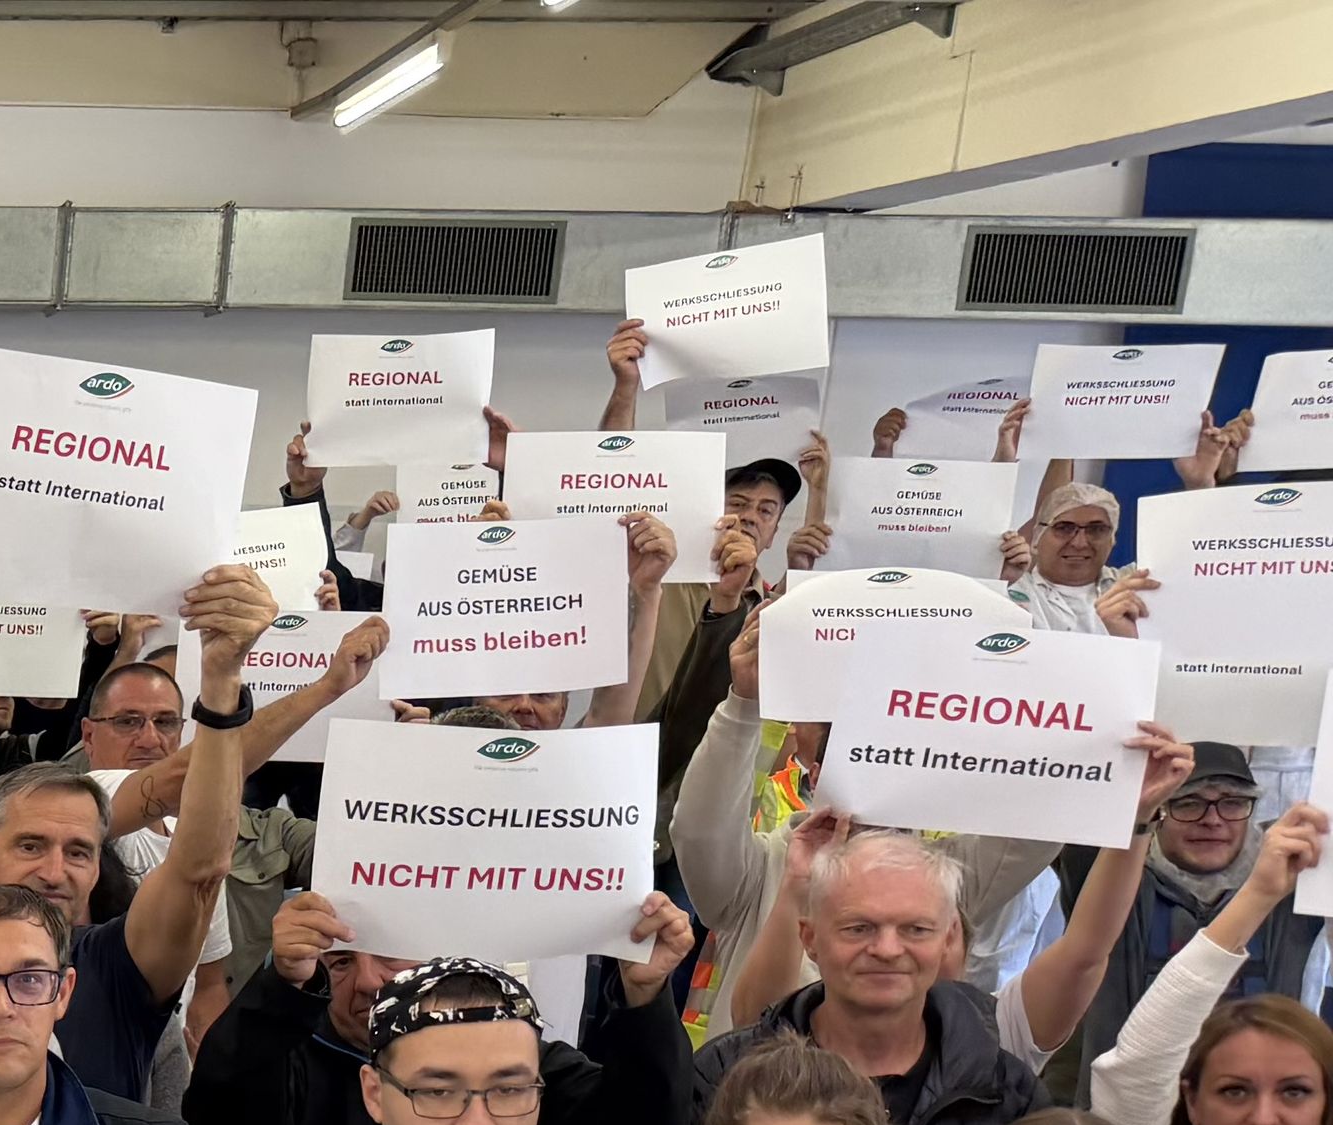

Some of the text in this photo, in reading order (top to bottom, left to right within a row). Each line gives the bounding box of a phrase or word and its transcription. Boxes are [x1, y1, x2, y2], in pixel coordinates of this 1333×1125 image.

[663, 283, 782, 309] WERKSSCHLIESSUNG
[666, 301, 780, 327] NICHT MIT UNS!!
[349, 371, 443, 386] REGIONAL
[1067, 379, 1175, 390] WERKSSCHLIESSUNG
[346, 396, 443, 406] statt International
[947, 391, 1019, 400] REGIONAL
[1065, 395, 1169, 406] NICHT MIT UNS!!
[1292, 398, 1314, 406] AUS
[704, 396, 779, 410] REGIONAL
[11, 425, 170, 471] REGIONAL
[441, 480, 487, 490] GEMÜSE
[561, 473, 668, 490] REGIONAL
[45, 480, 165, 511] International
[418, 498, 439, 506] AUS
[897, 491, 941, 500] GEMÜSE
[557, 504, 584, 513] statt
[871, 507, 962, 517] AUS ÖSTERREICH
[908, 523, 951, 533] bleiben!
[458, 565, 537, 584] GEMÜSE
[1195, 561, 1295, 576] NICHT MIT
[417, 594, 583, 616] AUS ÖSTERREICH
[812, 607, 973, 618] WERKSSCHLIESSUNG
[7, 624, 43, 635] UNS!!
[413, 626, 587, 653] muss bleiben!
[1176, 663, 1302, 675] statt International
[887, 689, 1093, 731] REGIONAL
[849, 744, 1112, 783] statt International
[345, 799, 639, 828] WERKSSCHLIESSUNG
[351, 862, 624, 891] NICHT MIT UNS!!
